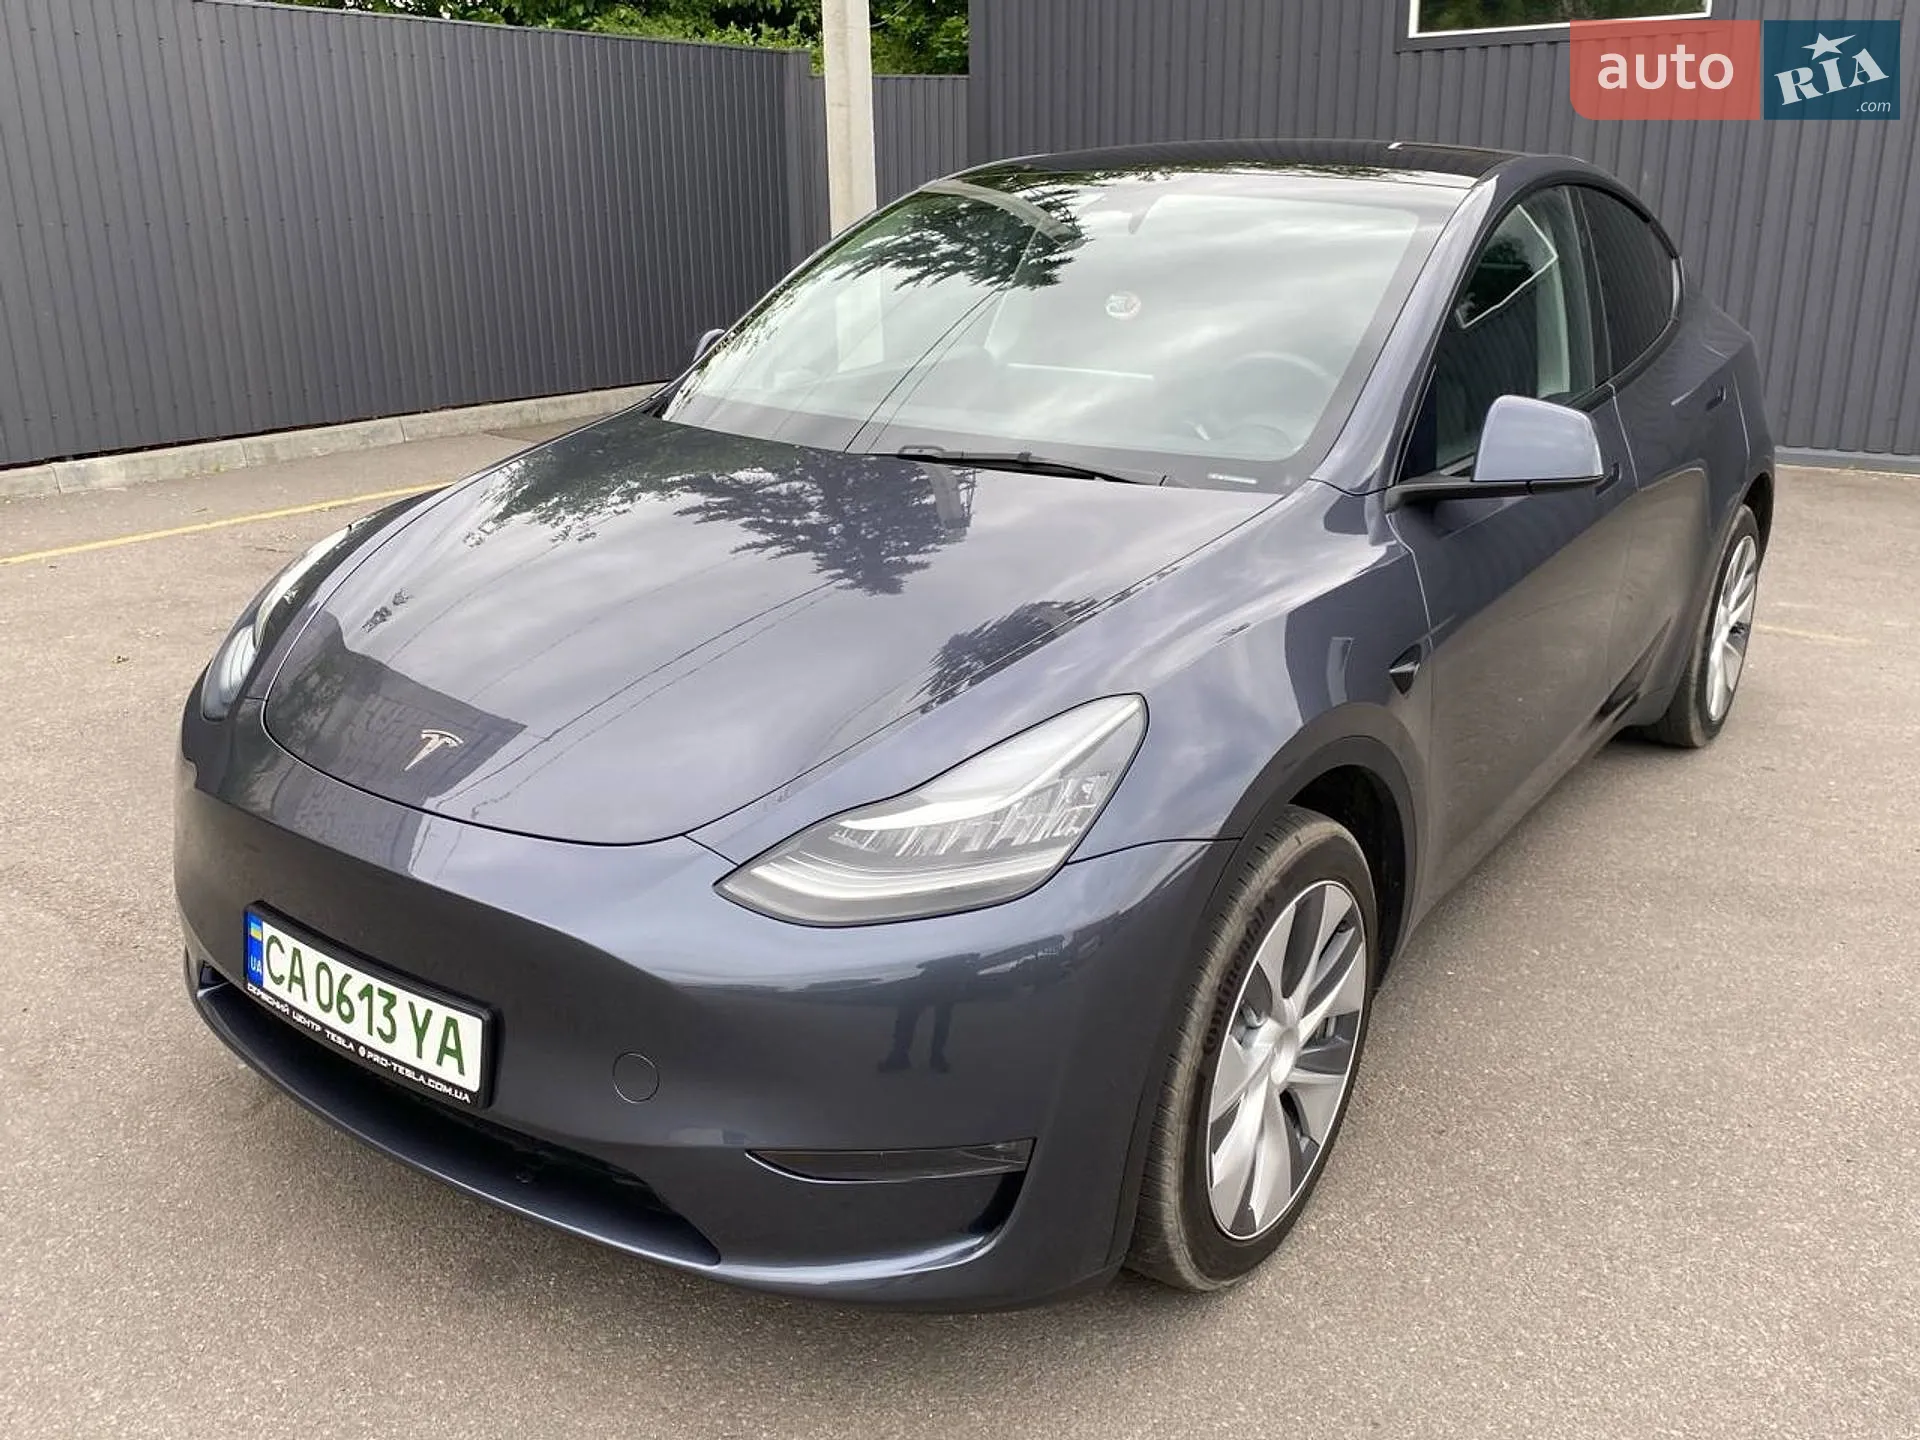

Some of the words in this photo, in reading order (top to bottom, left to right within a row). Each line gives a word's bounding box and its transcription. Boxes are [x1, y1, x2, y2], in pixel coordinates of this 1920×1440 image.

[250, 955, 263, 974] UA
[315, 961, 398, 1044] 0613
[407, 1000, 466, 1077] YA
[324, 1029, 356, 1052] TESLA
